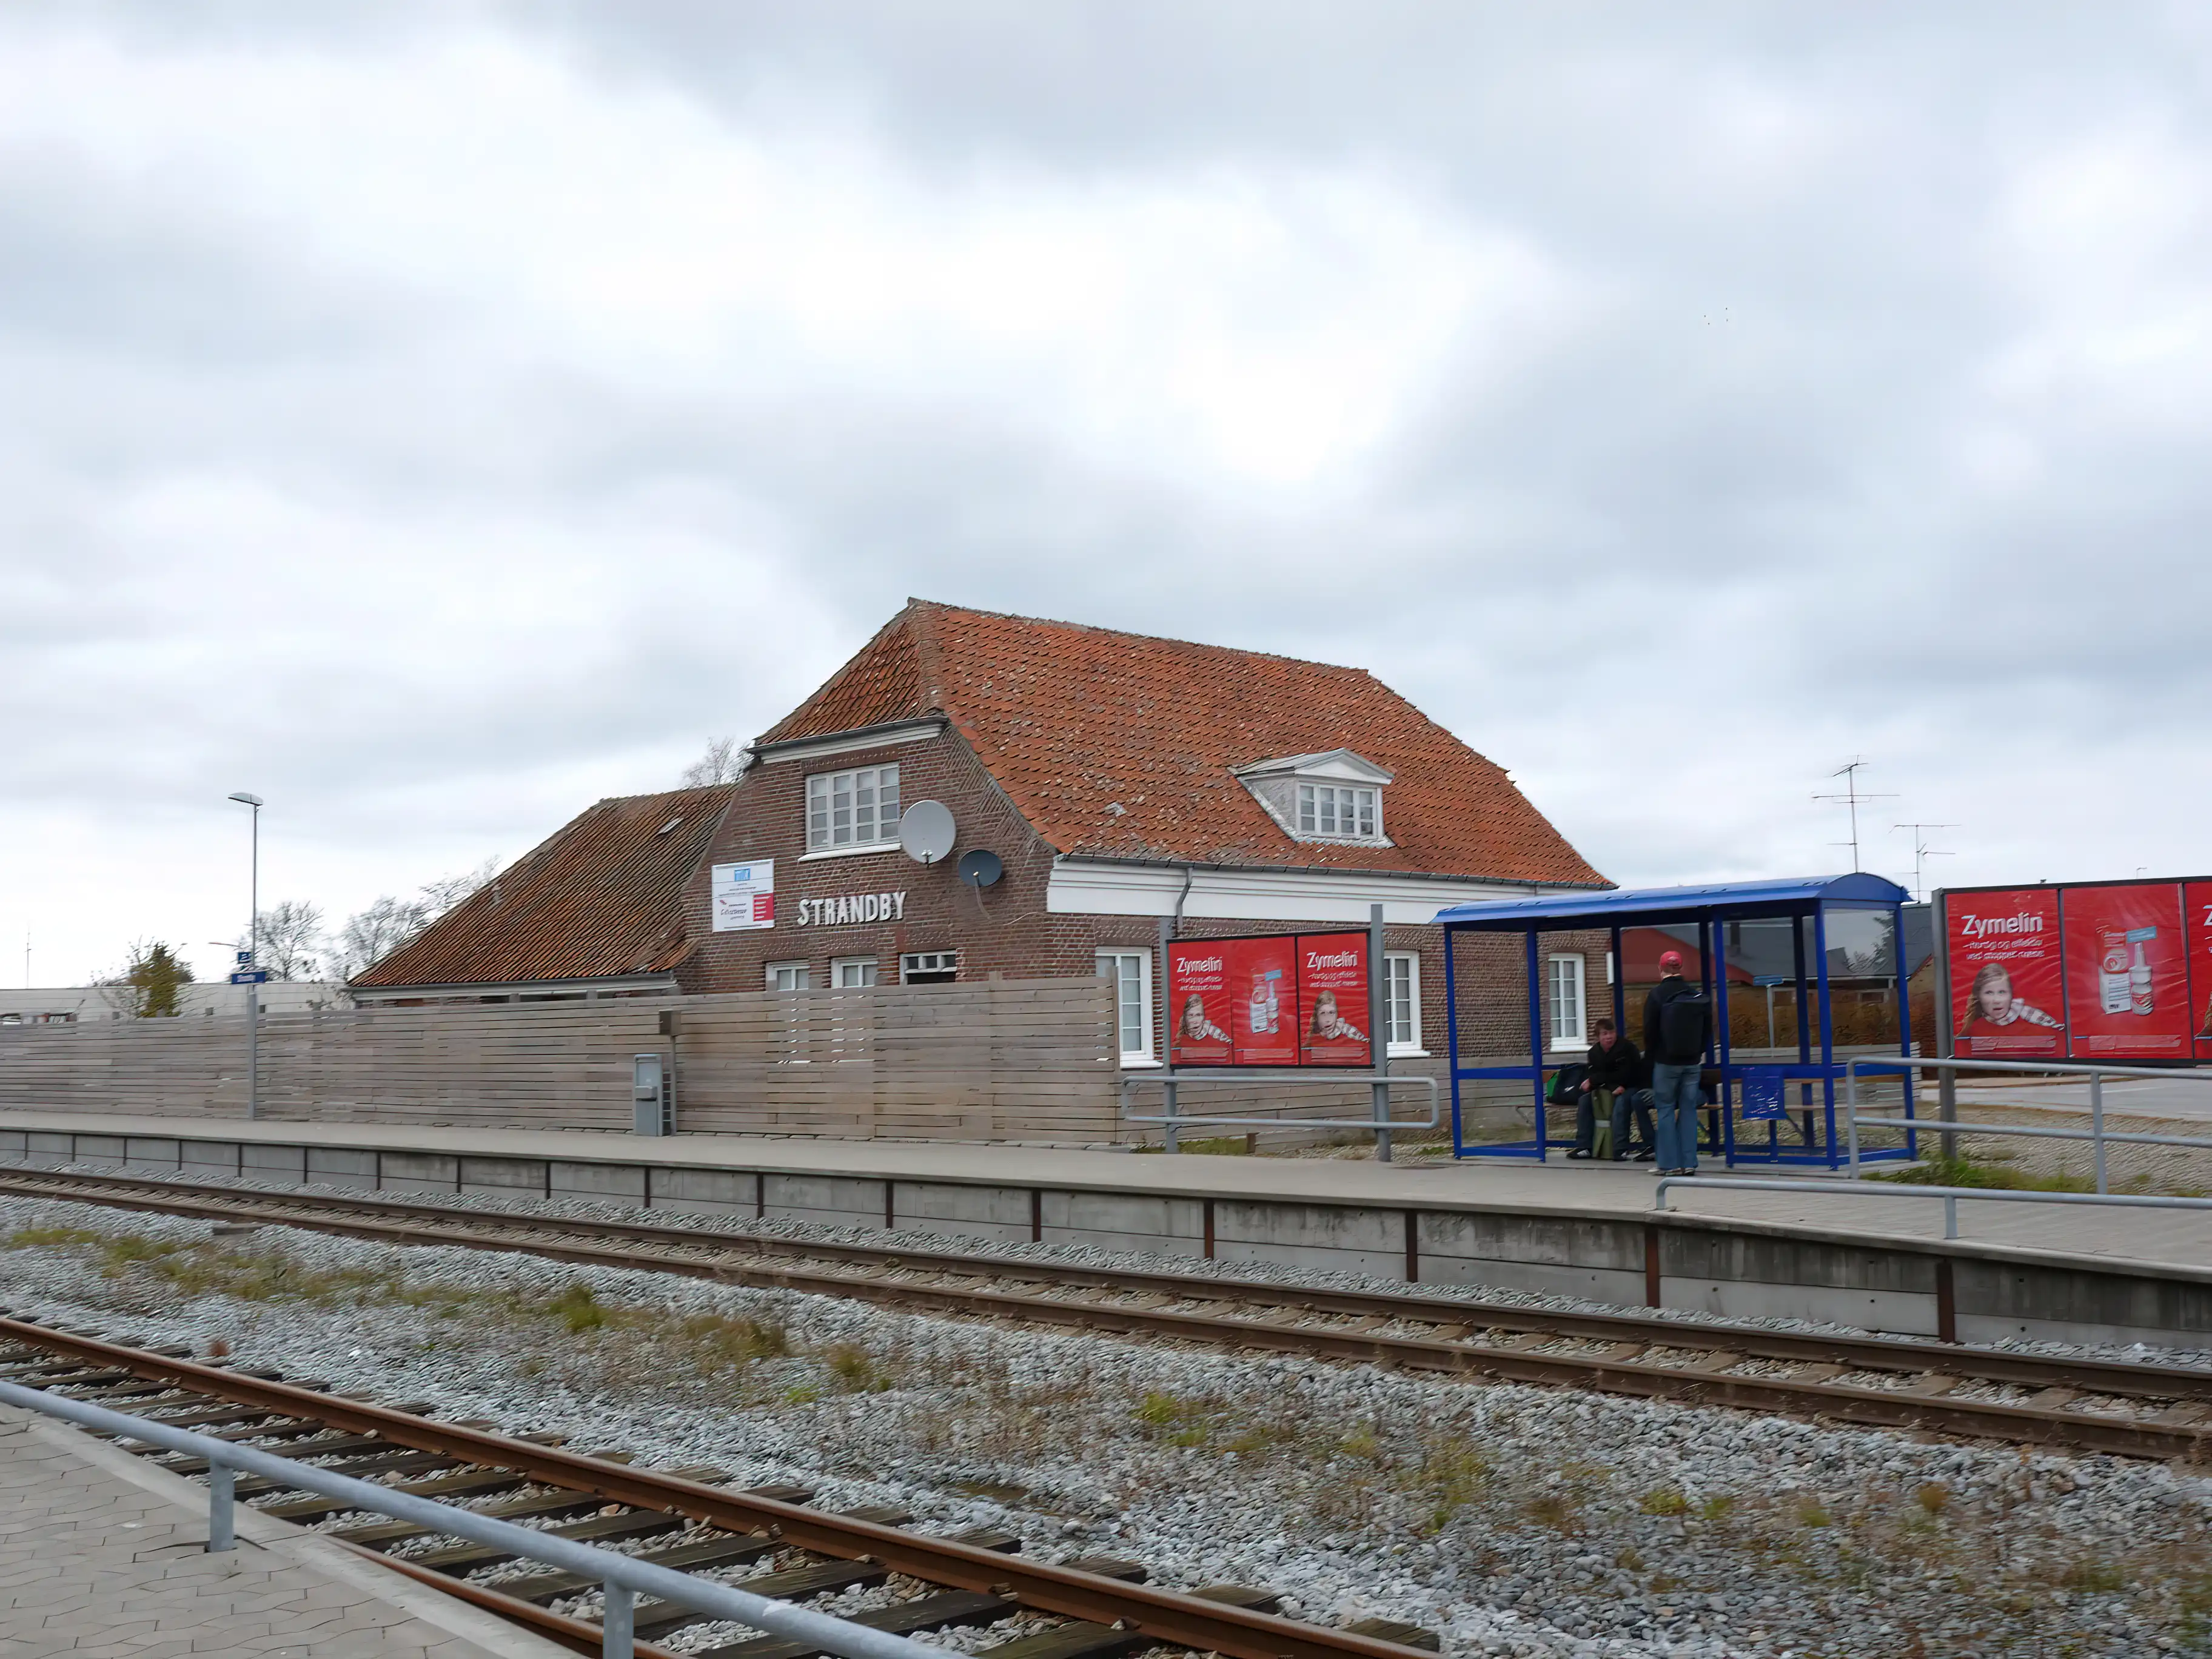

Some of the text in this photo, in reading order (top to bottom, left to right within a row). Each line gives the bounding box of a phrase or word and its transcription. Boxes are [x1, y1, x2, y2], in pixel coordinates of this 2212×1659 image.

[797, 891, 907, 927] STRANDBY
[1961, 912, 2043, 939] Zymelin
[1176, 956, 1223, 976] Zymelin
[1306, 951, 1358, 971] Zymelin
